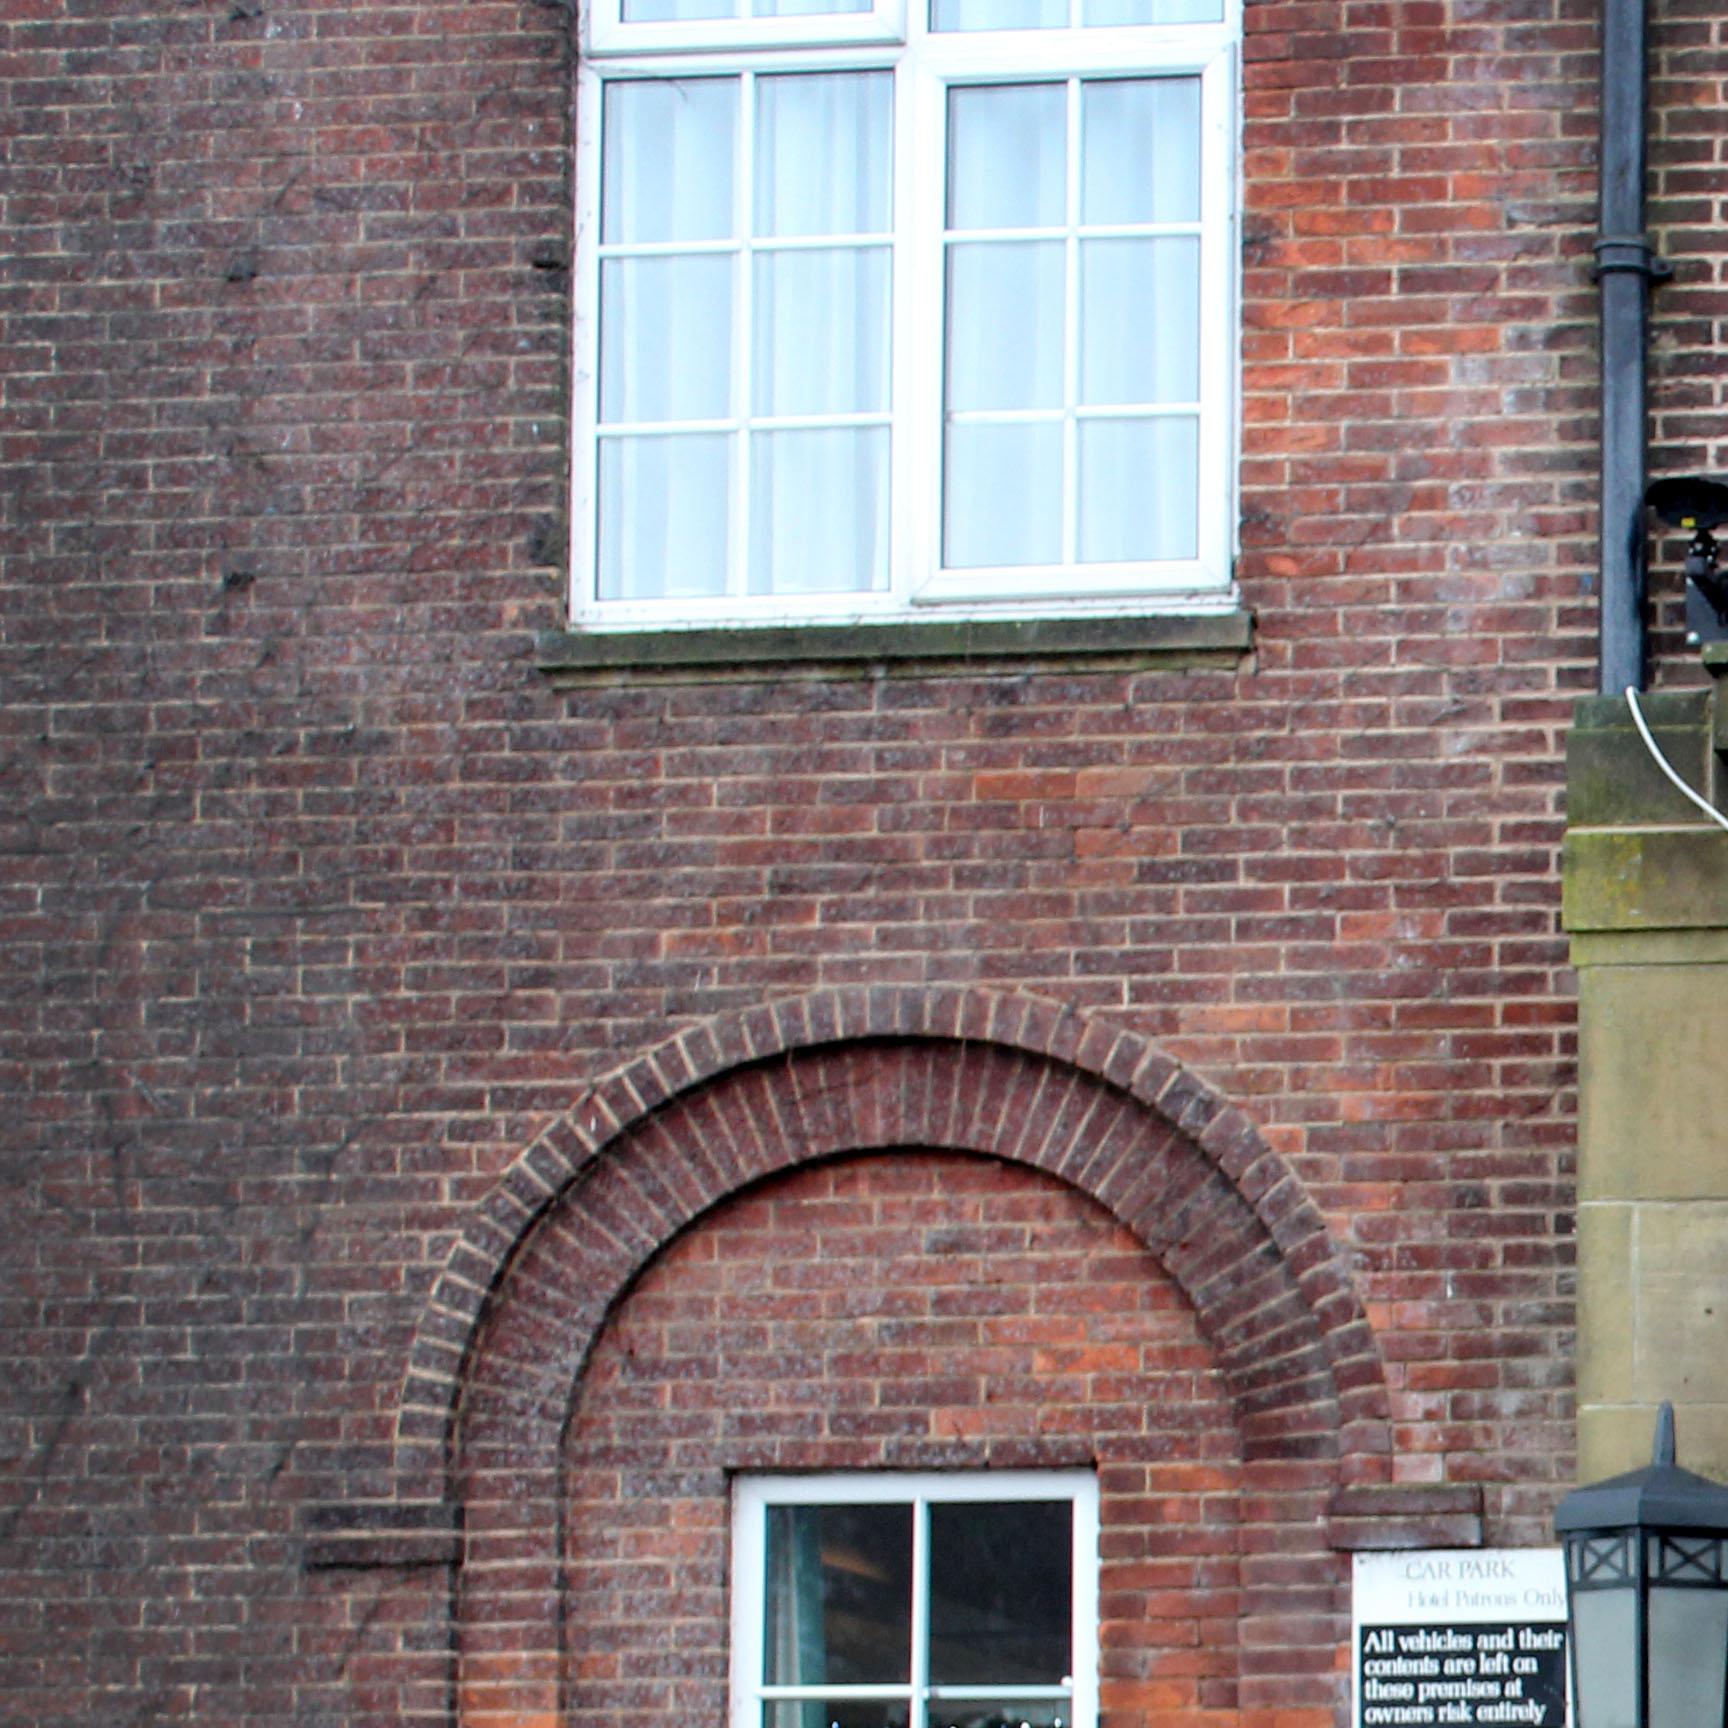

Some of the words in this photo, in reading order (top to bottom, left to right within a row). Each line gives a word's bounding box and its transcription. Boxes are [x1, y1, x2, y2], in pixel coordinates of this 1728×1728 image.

[1405, 1561, 1450, 1580] CAR
[1459, 1560, 1515, 1579] PARK
[1523, 1587, 1566, 1610] Only
[1363, 1630, 1395, 1653] All
[1398, 1628, 1473, 1652] vehicles
[1477, 1627, 1514, 1650] and
[1518, 1627, 1564, 1650] their
[1363, 1656, 1440, 1677] contents
[1443, 1657, 1476, 1675] are
[1479, 1652, 1510, 1674] left
[1513, 1657, 1539, 1674] on
[1363, 1679, 1415, 1700] these
[1418, 1677, 1501, 1703] premises
[1504, 1677, 1523, 1698] at
[1364, 1703, 1435, 1724] owners
[1438, 1700, 1473, 1723] risk
[1476, 1699, 1547, 1726] entirely
